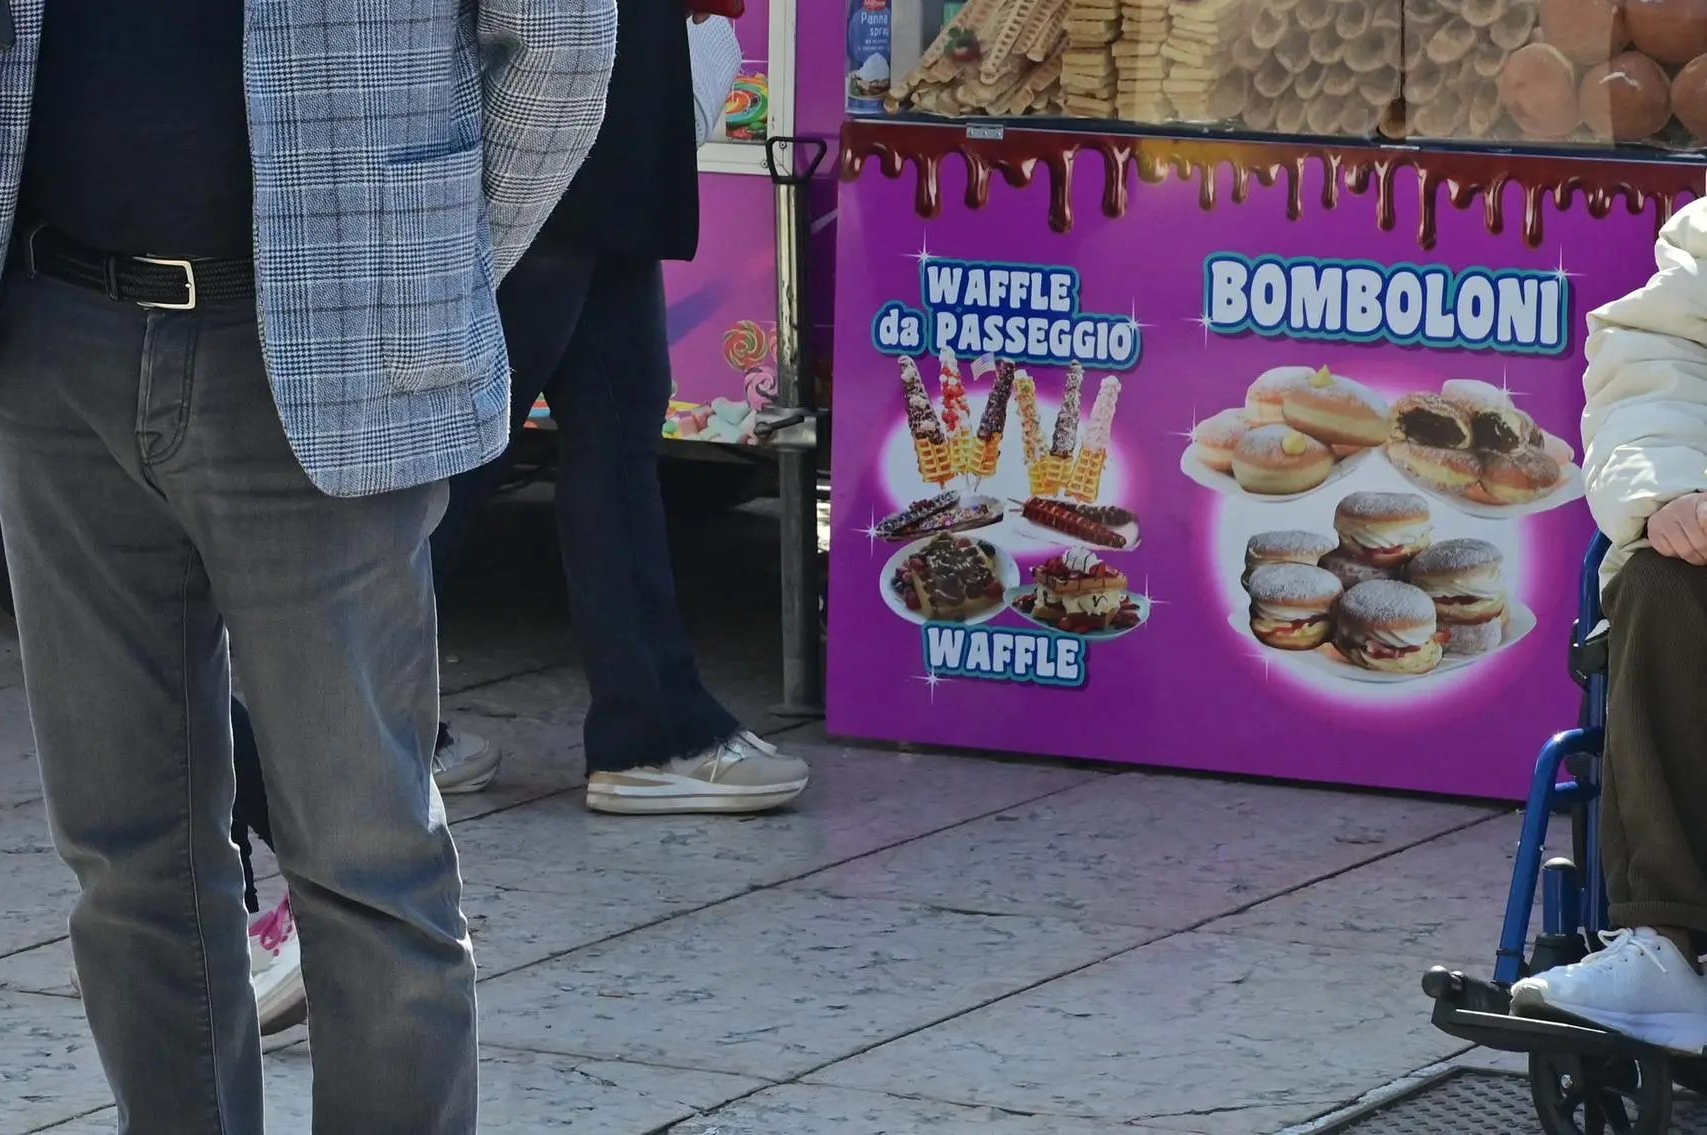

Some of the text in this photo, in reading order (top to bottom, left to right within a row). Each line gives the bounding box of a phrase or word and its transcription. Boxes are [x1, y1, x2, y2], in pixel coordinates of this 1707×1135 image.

[927, 266, 1071, 312] WAFFLE
[1211, 261, 1562, 347] BOMBOLONI
[879, 309, 1133, 361] da PASSEGGIO
[927, 626, 1079, 678] WAFFLE
